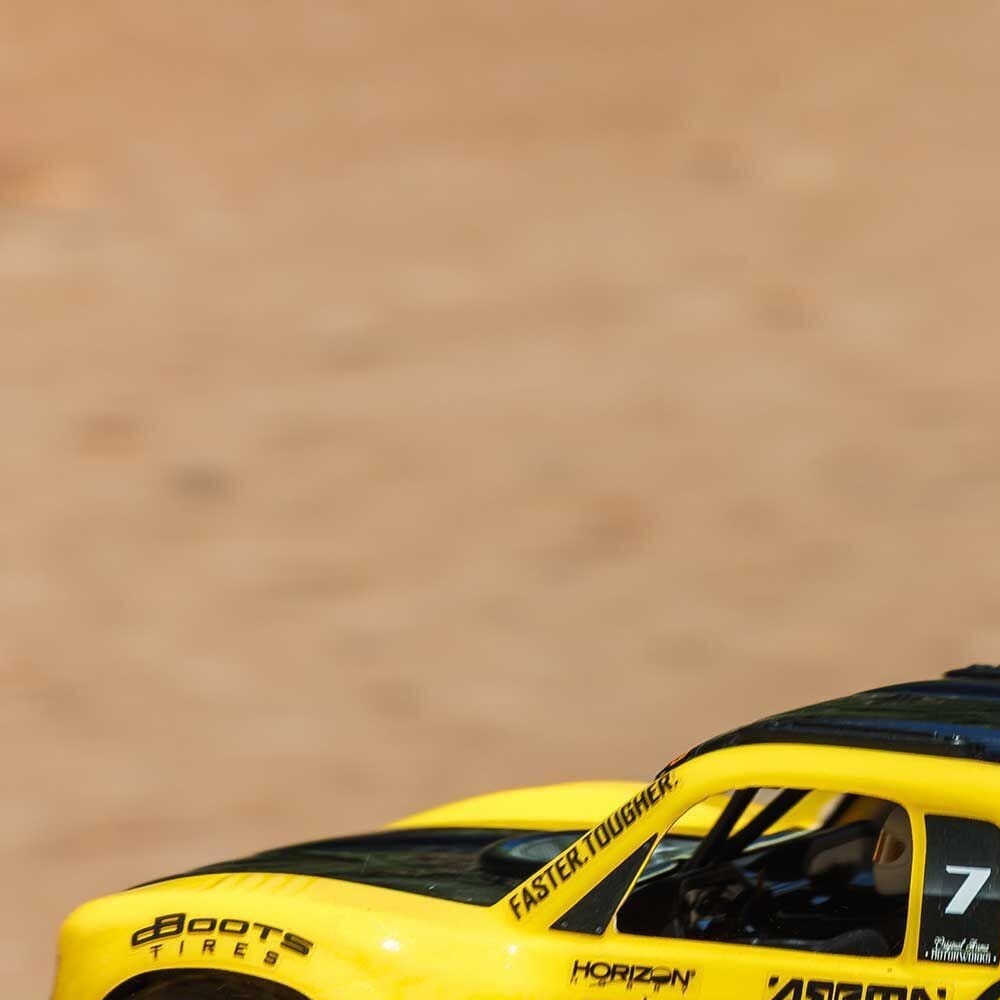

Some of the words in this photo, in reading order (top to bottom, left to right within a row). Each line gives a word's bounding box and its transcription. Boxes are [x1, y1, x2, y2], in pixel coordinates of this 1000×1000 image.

[945, 865, 991, 914] 7
[150, 939, 279, 965] TIRES
[572, 959, 691, 986] HORIZON
